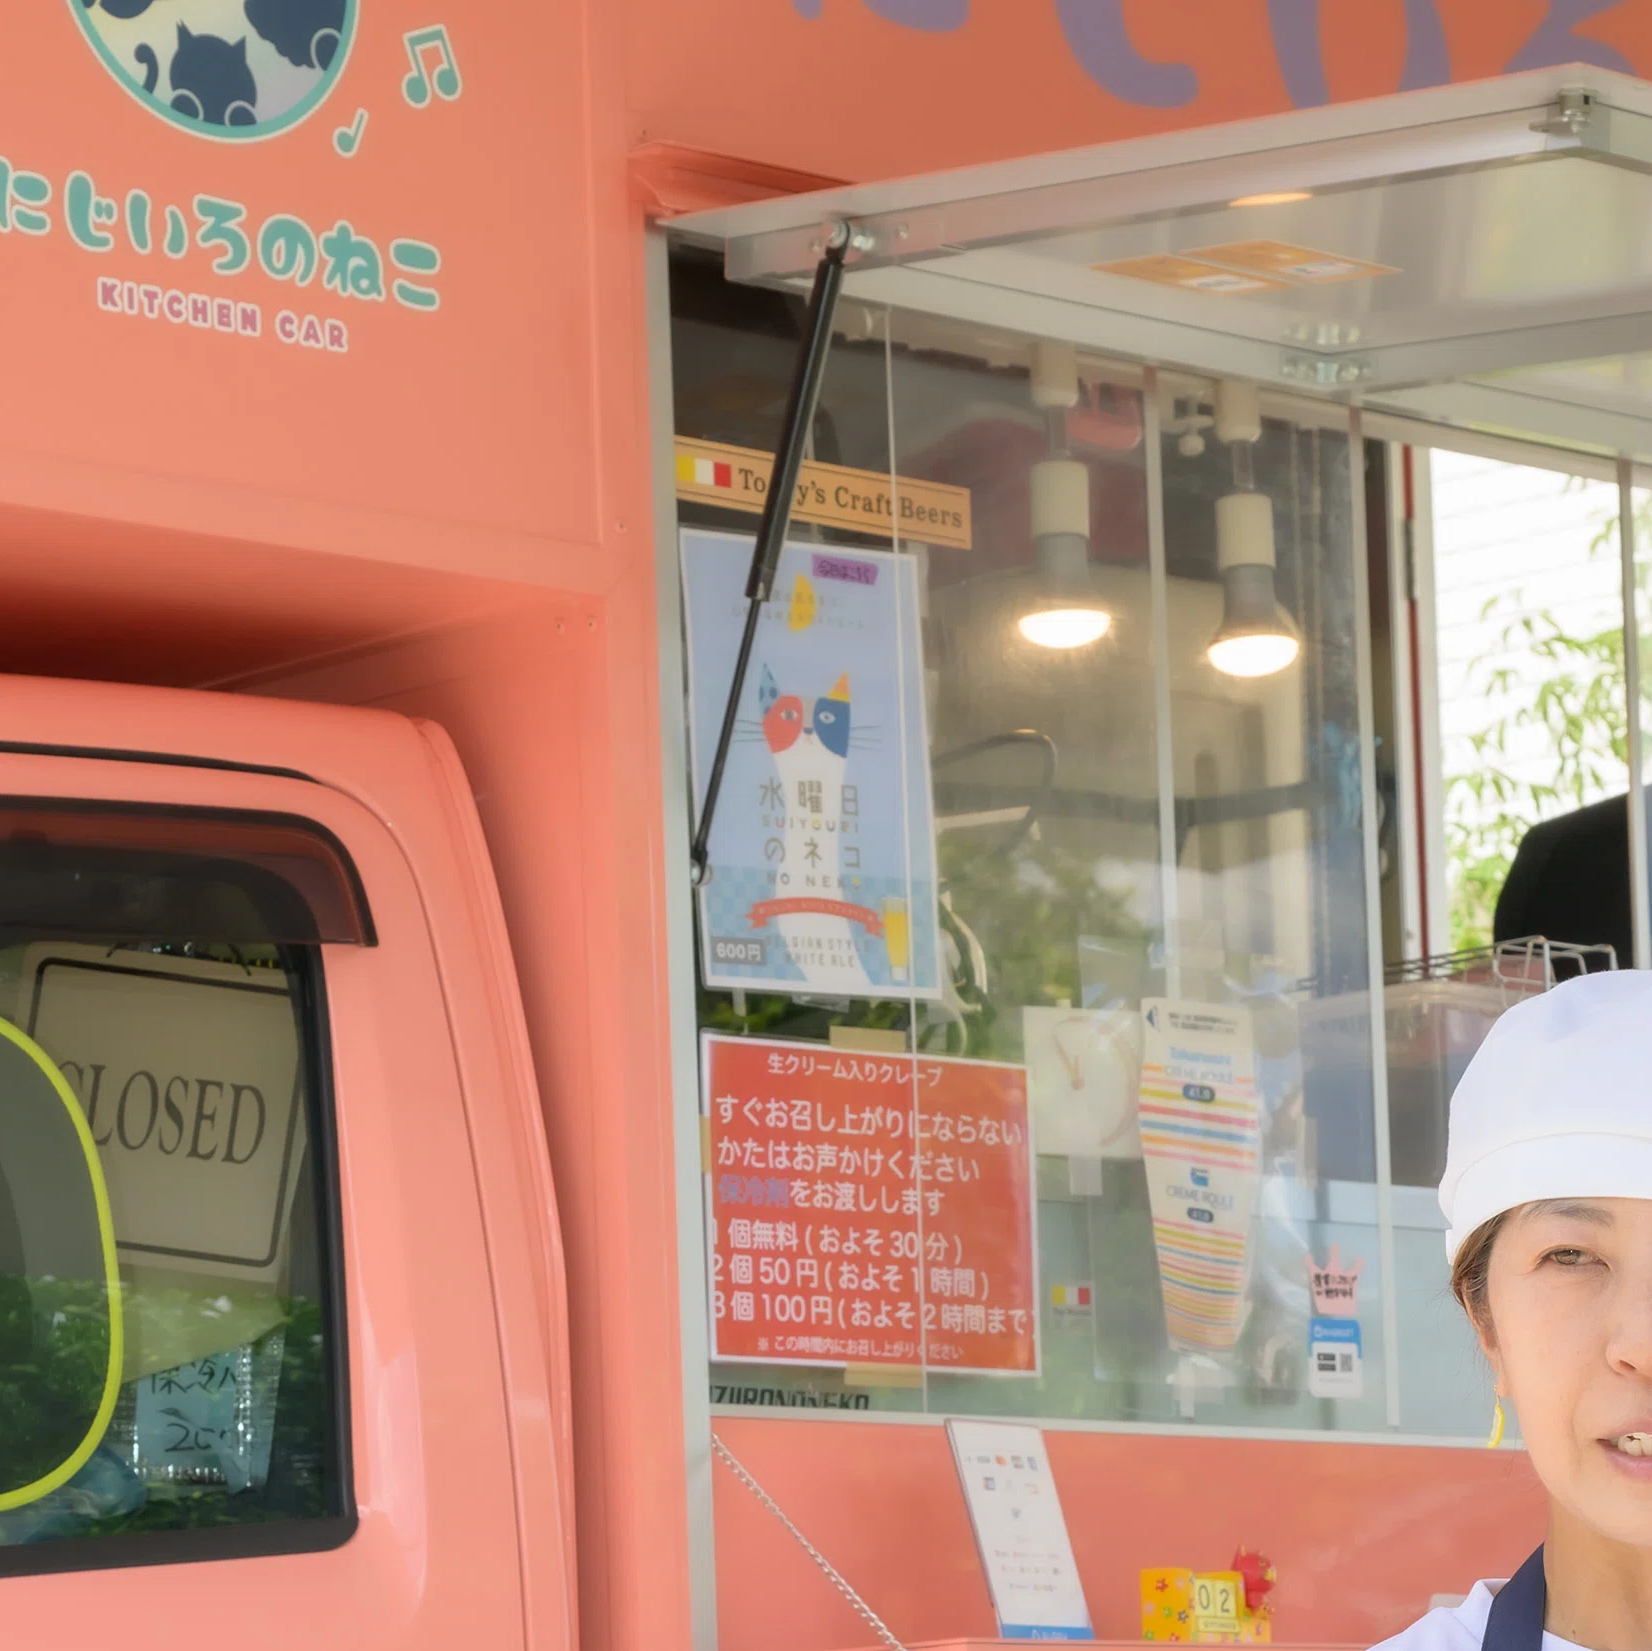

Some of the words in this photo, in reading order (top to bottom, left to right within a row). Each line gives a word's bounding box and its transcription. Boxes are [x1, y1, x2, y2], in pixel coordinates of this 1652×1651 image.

[98, 277, 261, 336] KITCHEN
[275, 308, 349, 352] CAR
[738, 467, 826, 505] Toy's
[835, 486, 893, 516] Craft
[900, 496, 963, 528] Beers
[759, 776, 859, 816] 水曜日
[762, 815, 859, 834] SUIYOUBI
[763, 836, 861, 869] のネコ
[716, 941, 762, 963] 600円
[767, 1052, 943, 1086] 生クリーム入りクレープ
[716, 1094, 1024, 1147] すぐお召し上がりにならない
[718, 1136, 981, 1182] かたはお声かけください
[719, 1174, 946, 1217] 保冷剤をお渡しします
